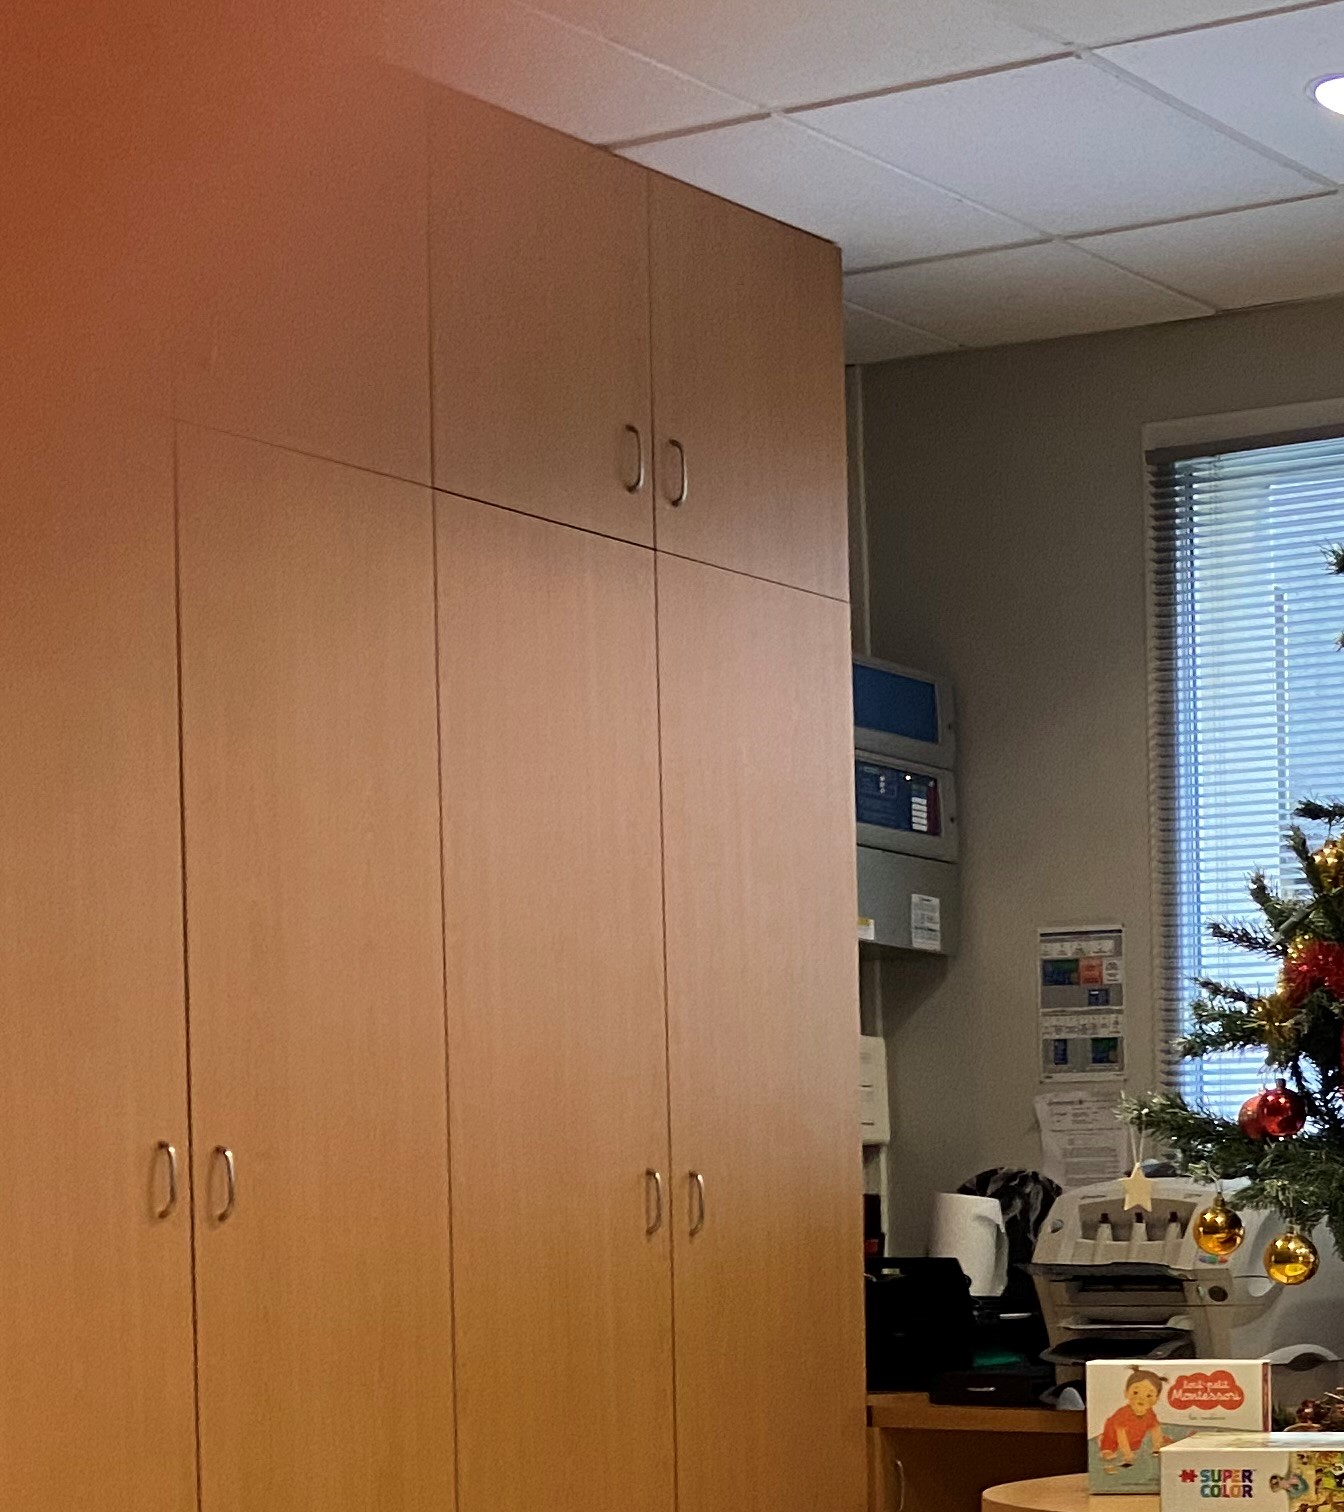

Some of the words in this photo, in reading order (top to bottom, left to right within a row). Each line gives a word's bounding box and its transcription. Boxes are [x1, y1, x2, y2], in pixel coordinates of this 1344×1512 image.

[1171, 1388, 1242, 1402] Montessori
[1200, 1469, 1253, 1483] SUPER
[1200, 1484, 1253, 1498] COLOR
